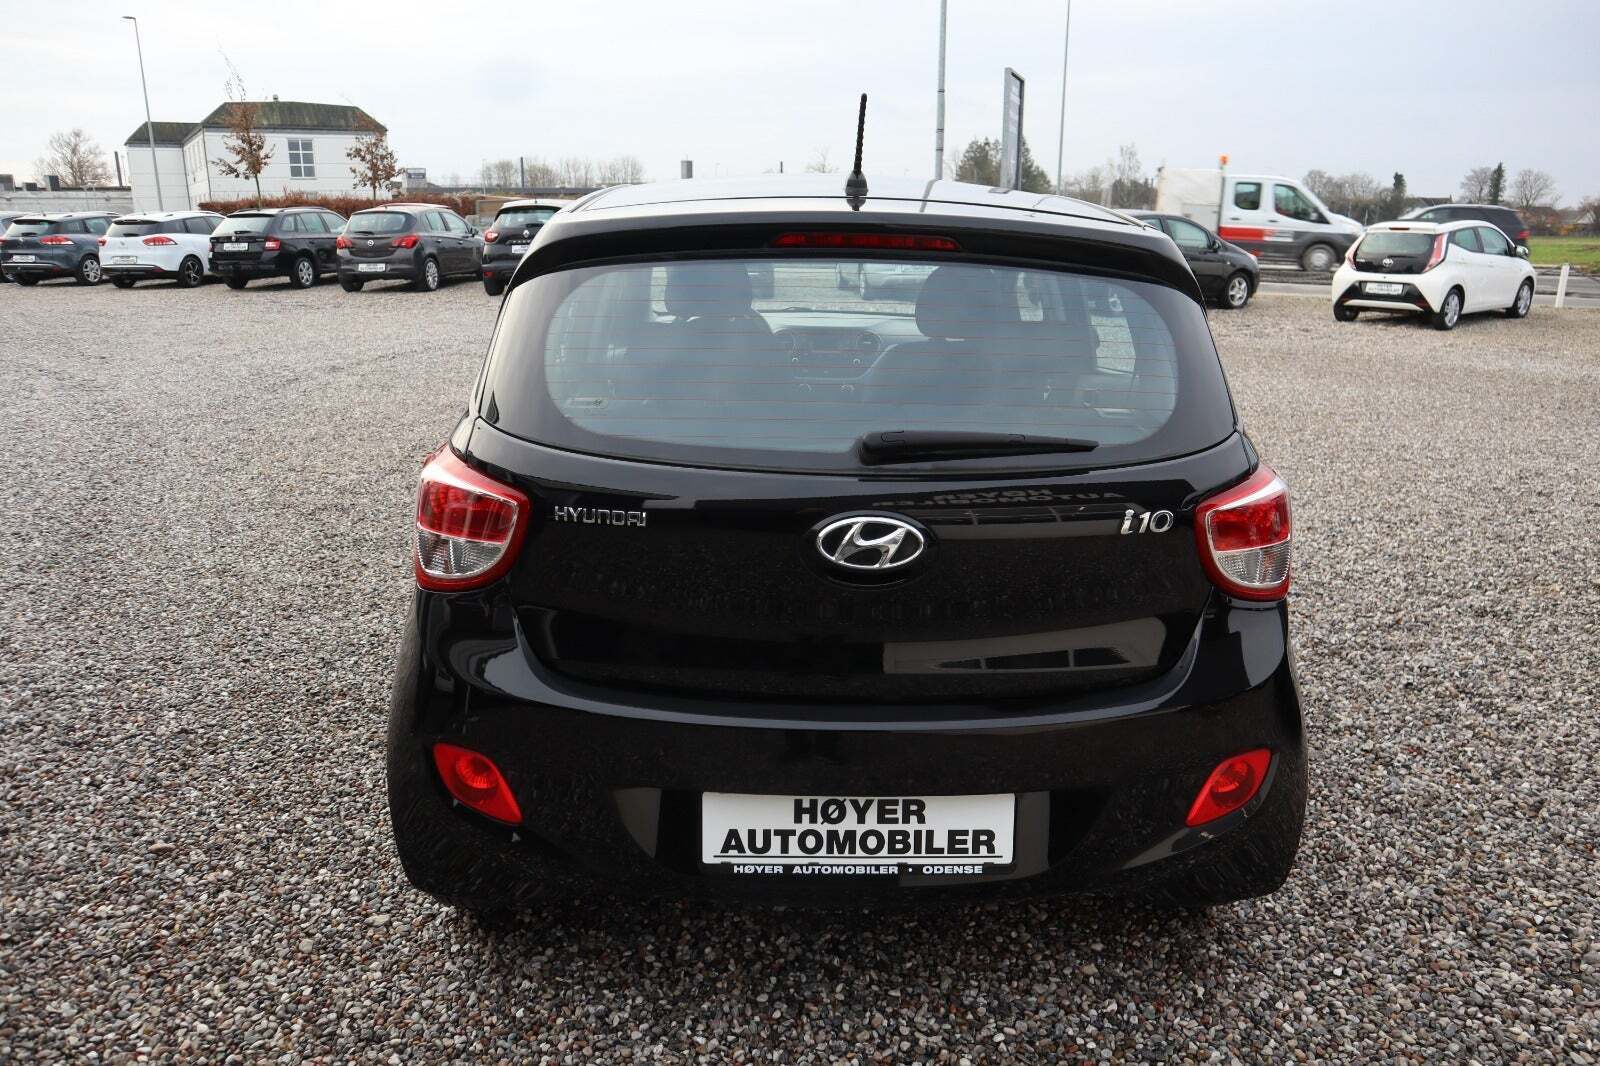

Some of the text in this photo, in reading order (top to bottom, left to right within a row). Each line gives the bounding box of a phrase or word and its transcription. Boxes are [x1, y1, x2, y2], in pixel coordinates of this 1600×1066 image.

[554, 505, 647, 527] HYUNDAI
[1120, 509, 1174, 535] i10
[793, 797, 927, 825] HØYER
[719, 829, 996, 855] AUTOMOBILER
[733, 864, 983, 875] HØYER AUTOMOBILER ODENSE
